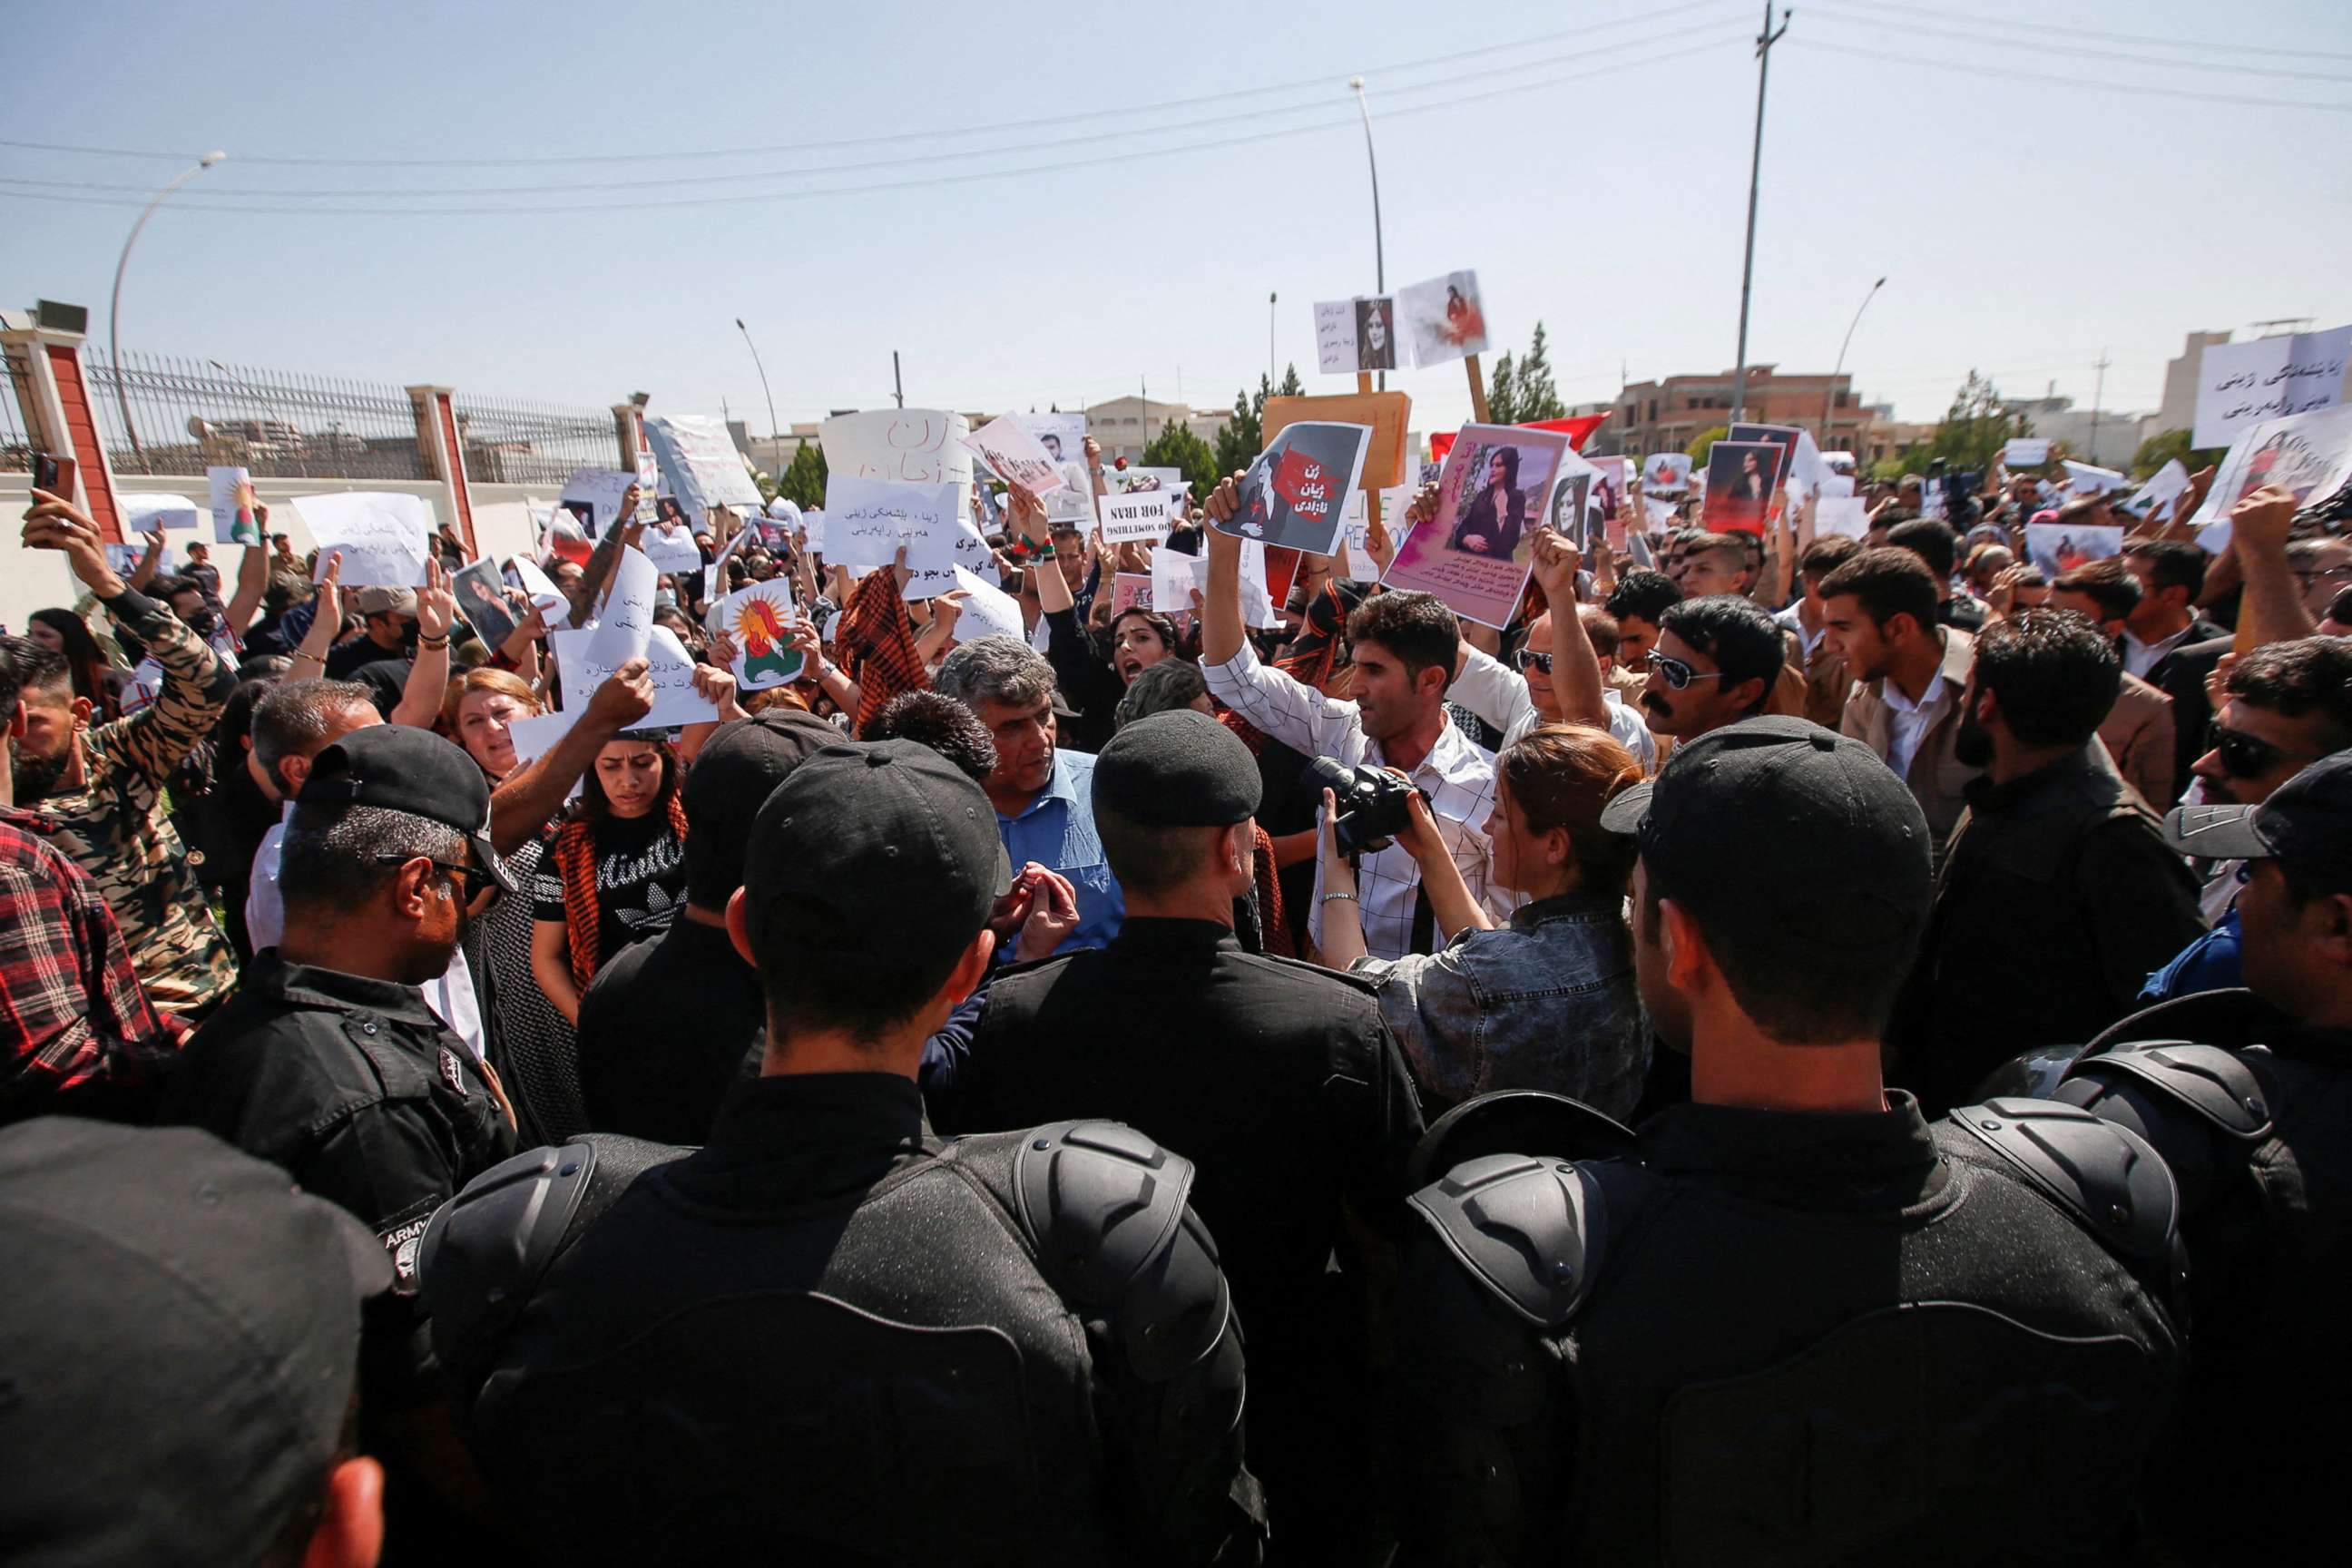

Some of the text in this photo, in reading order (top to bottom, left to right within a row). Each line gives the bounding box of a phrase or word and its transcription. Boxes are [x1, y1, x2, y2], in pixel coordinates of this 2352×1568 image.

[1304, 464, 1320, 479] ژن
[1299, 482, 1325, 499] ژیان
[1110, 504, 1164, 521] FOR IRAN
[1106, 522, 1171, 536] DO SOMETHING
[386, 1220, 426, 1250] ARMY
